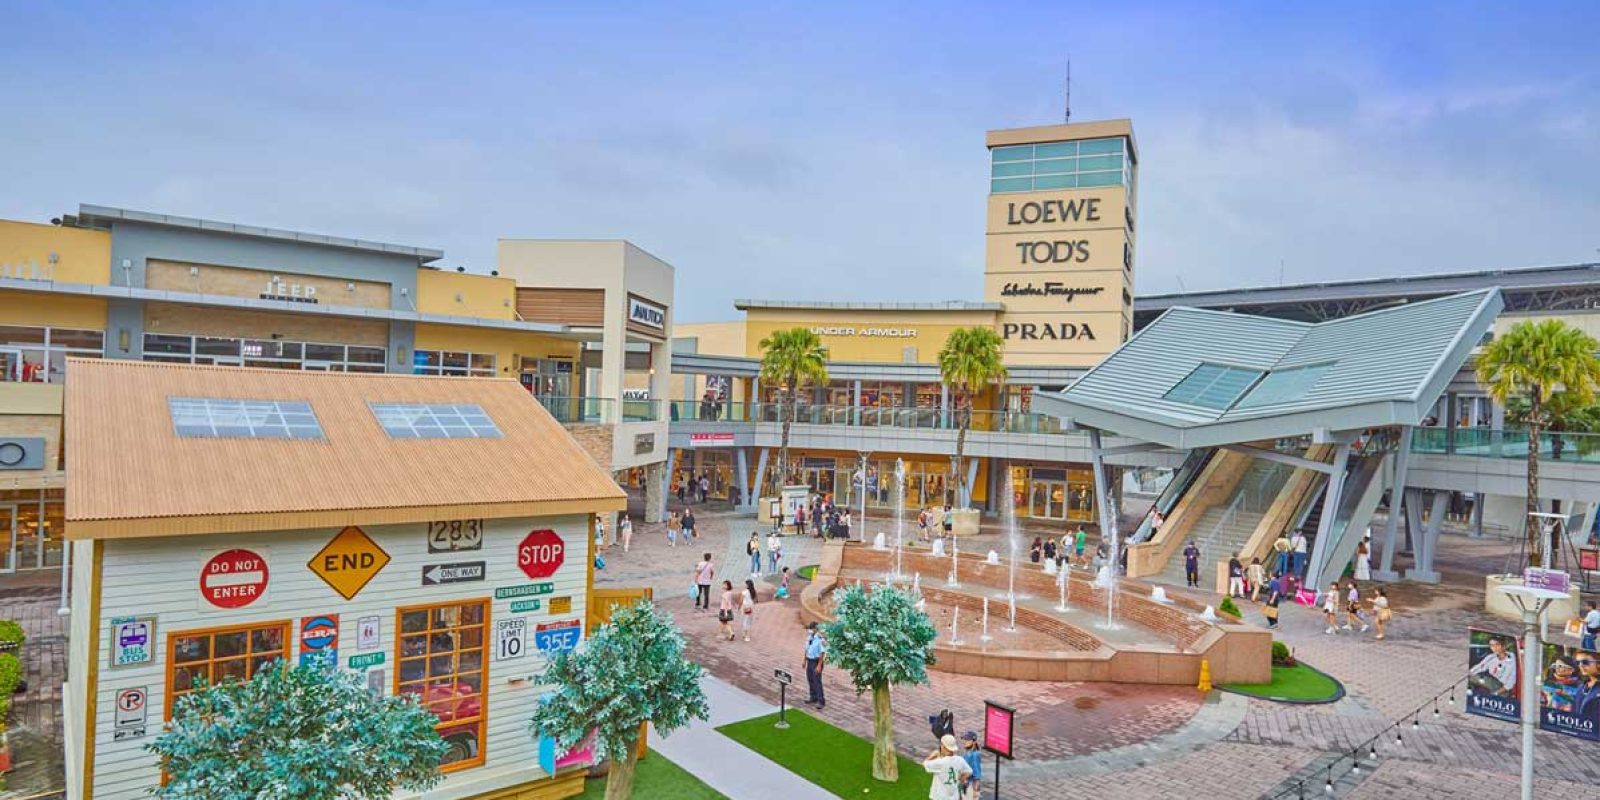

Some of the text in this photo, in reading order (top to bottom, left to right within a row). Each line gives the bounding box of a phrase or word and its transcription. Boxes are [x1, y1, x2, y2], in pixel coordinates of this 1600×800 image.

[1008, 199, 1101, 225] LOEWE
[1016, 240, 1089, 264] TOD'S
[263, 281, 316, 298] JEEP
[810, 327, 917, 337] UNDER ARMOUR
[1002, 323, 1095, 340] PRADA
[434, 520, 477, 542] 283
[324, 552, 375, 571] END
[520, 544, 562, 565] STOP
[211, 560, 259, 573] DO NOT
[441, 567, 479, 578] ONE WAY
[213, 586, 256, 599] ENTER
[499, 620, 524, 630] SPEED
[501, 629, 522, 639] LIMIT
[502, 637, 521, 657] 10
[541, 632, 573, 652] 35E
[122, 647, 144, 655] BUS
[119, 653, 148, 664] STOP
[352, 653, 376, 666] FRONT
[1481, 697, 1515, 711] POLO
[1556, 714, 1593, 729] POLO
